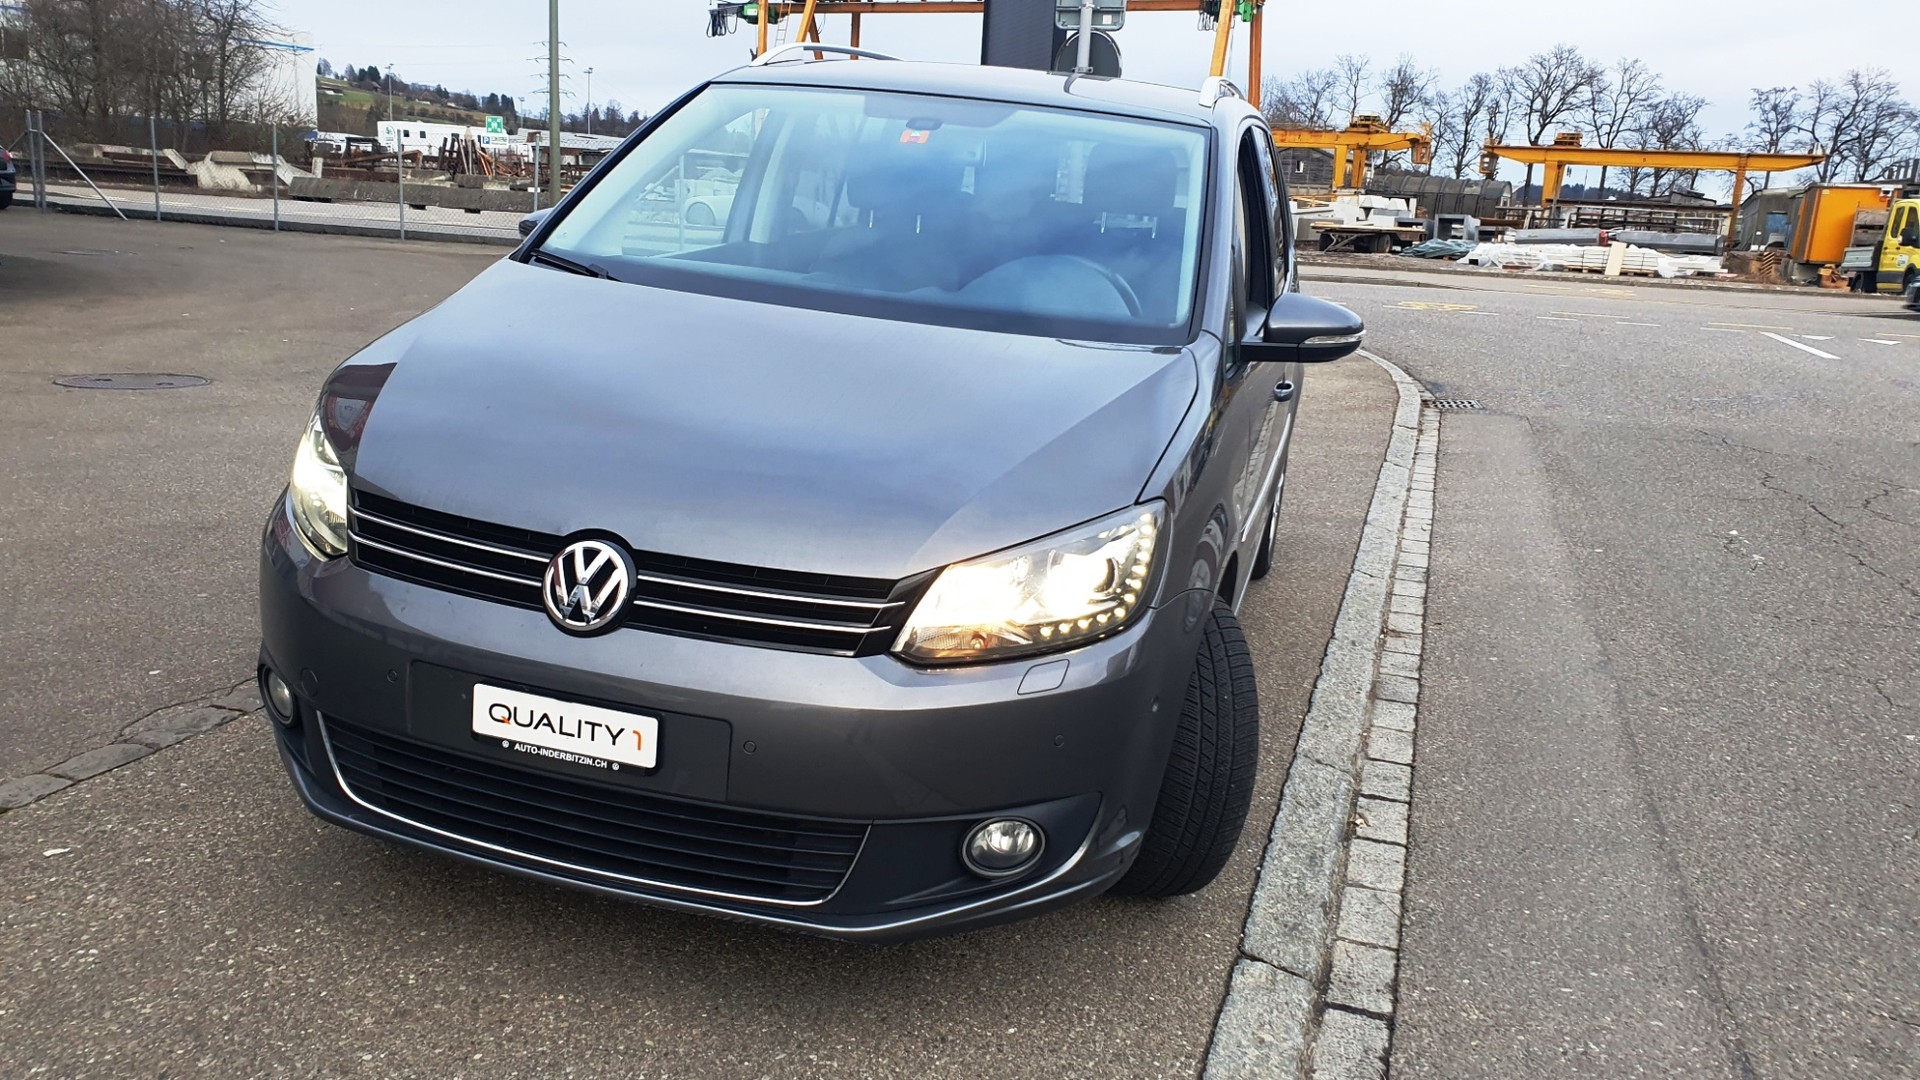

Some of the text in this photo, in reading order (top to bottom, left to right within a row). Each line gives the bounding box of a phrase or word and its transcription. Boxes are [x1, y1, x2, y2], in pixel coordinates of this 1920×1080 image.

[488, 702, 642, 751] QUALITY 1
[514, 743, 608, 769] AUTO-INDERBITZIN.CH
